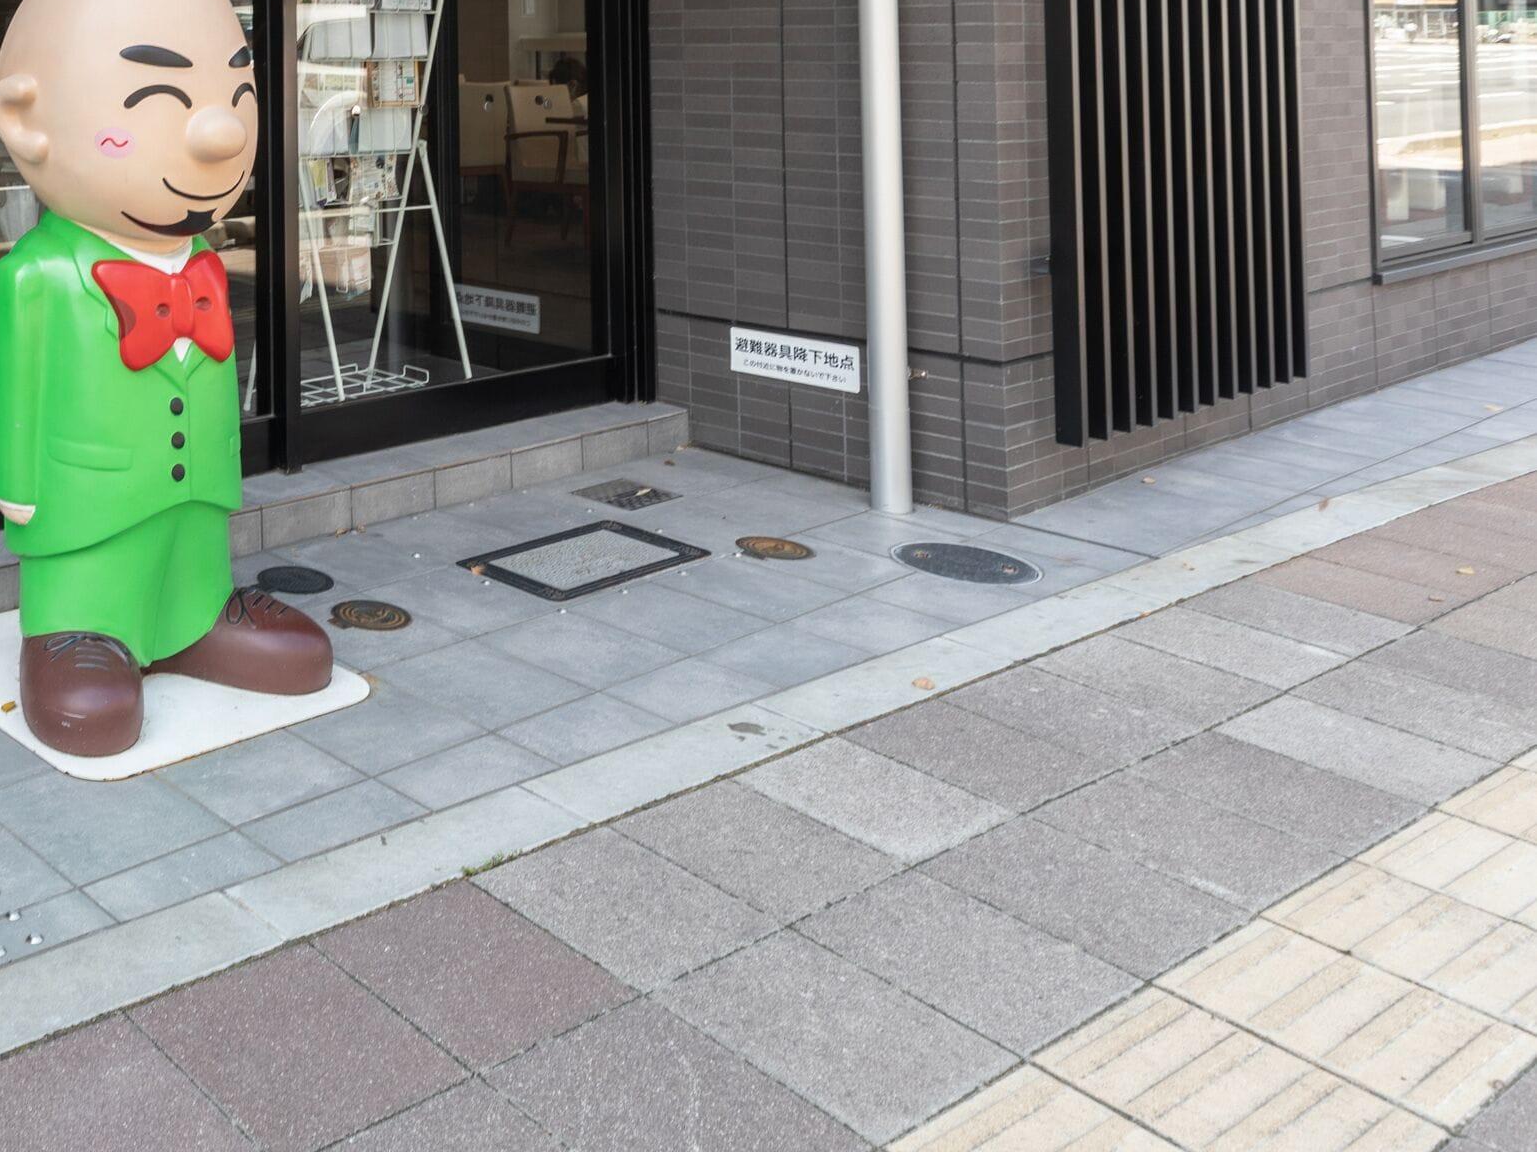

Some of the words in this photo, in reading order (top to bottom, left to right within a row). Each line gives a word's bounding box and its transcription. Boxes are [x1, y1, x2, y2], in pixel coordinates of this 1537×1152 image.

[735, 337, 855, 371] 避難器具降下地点
